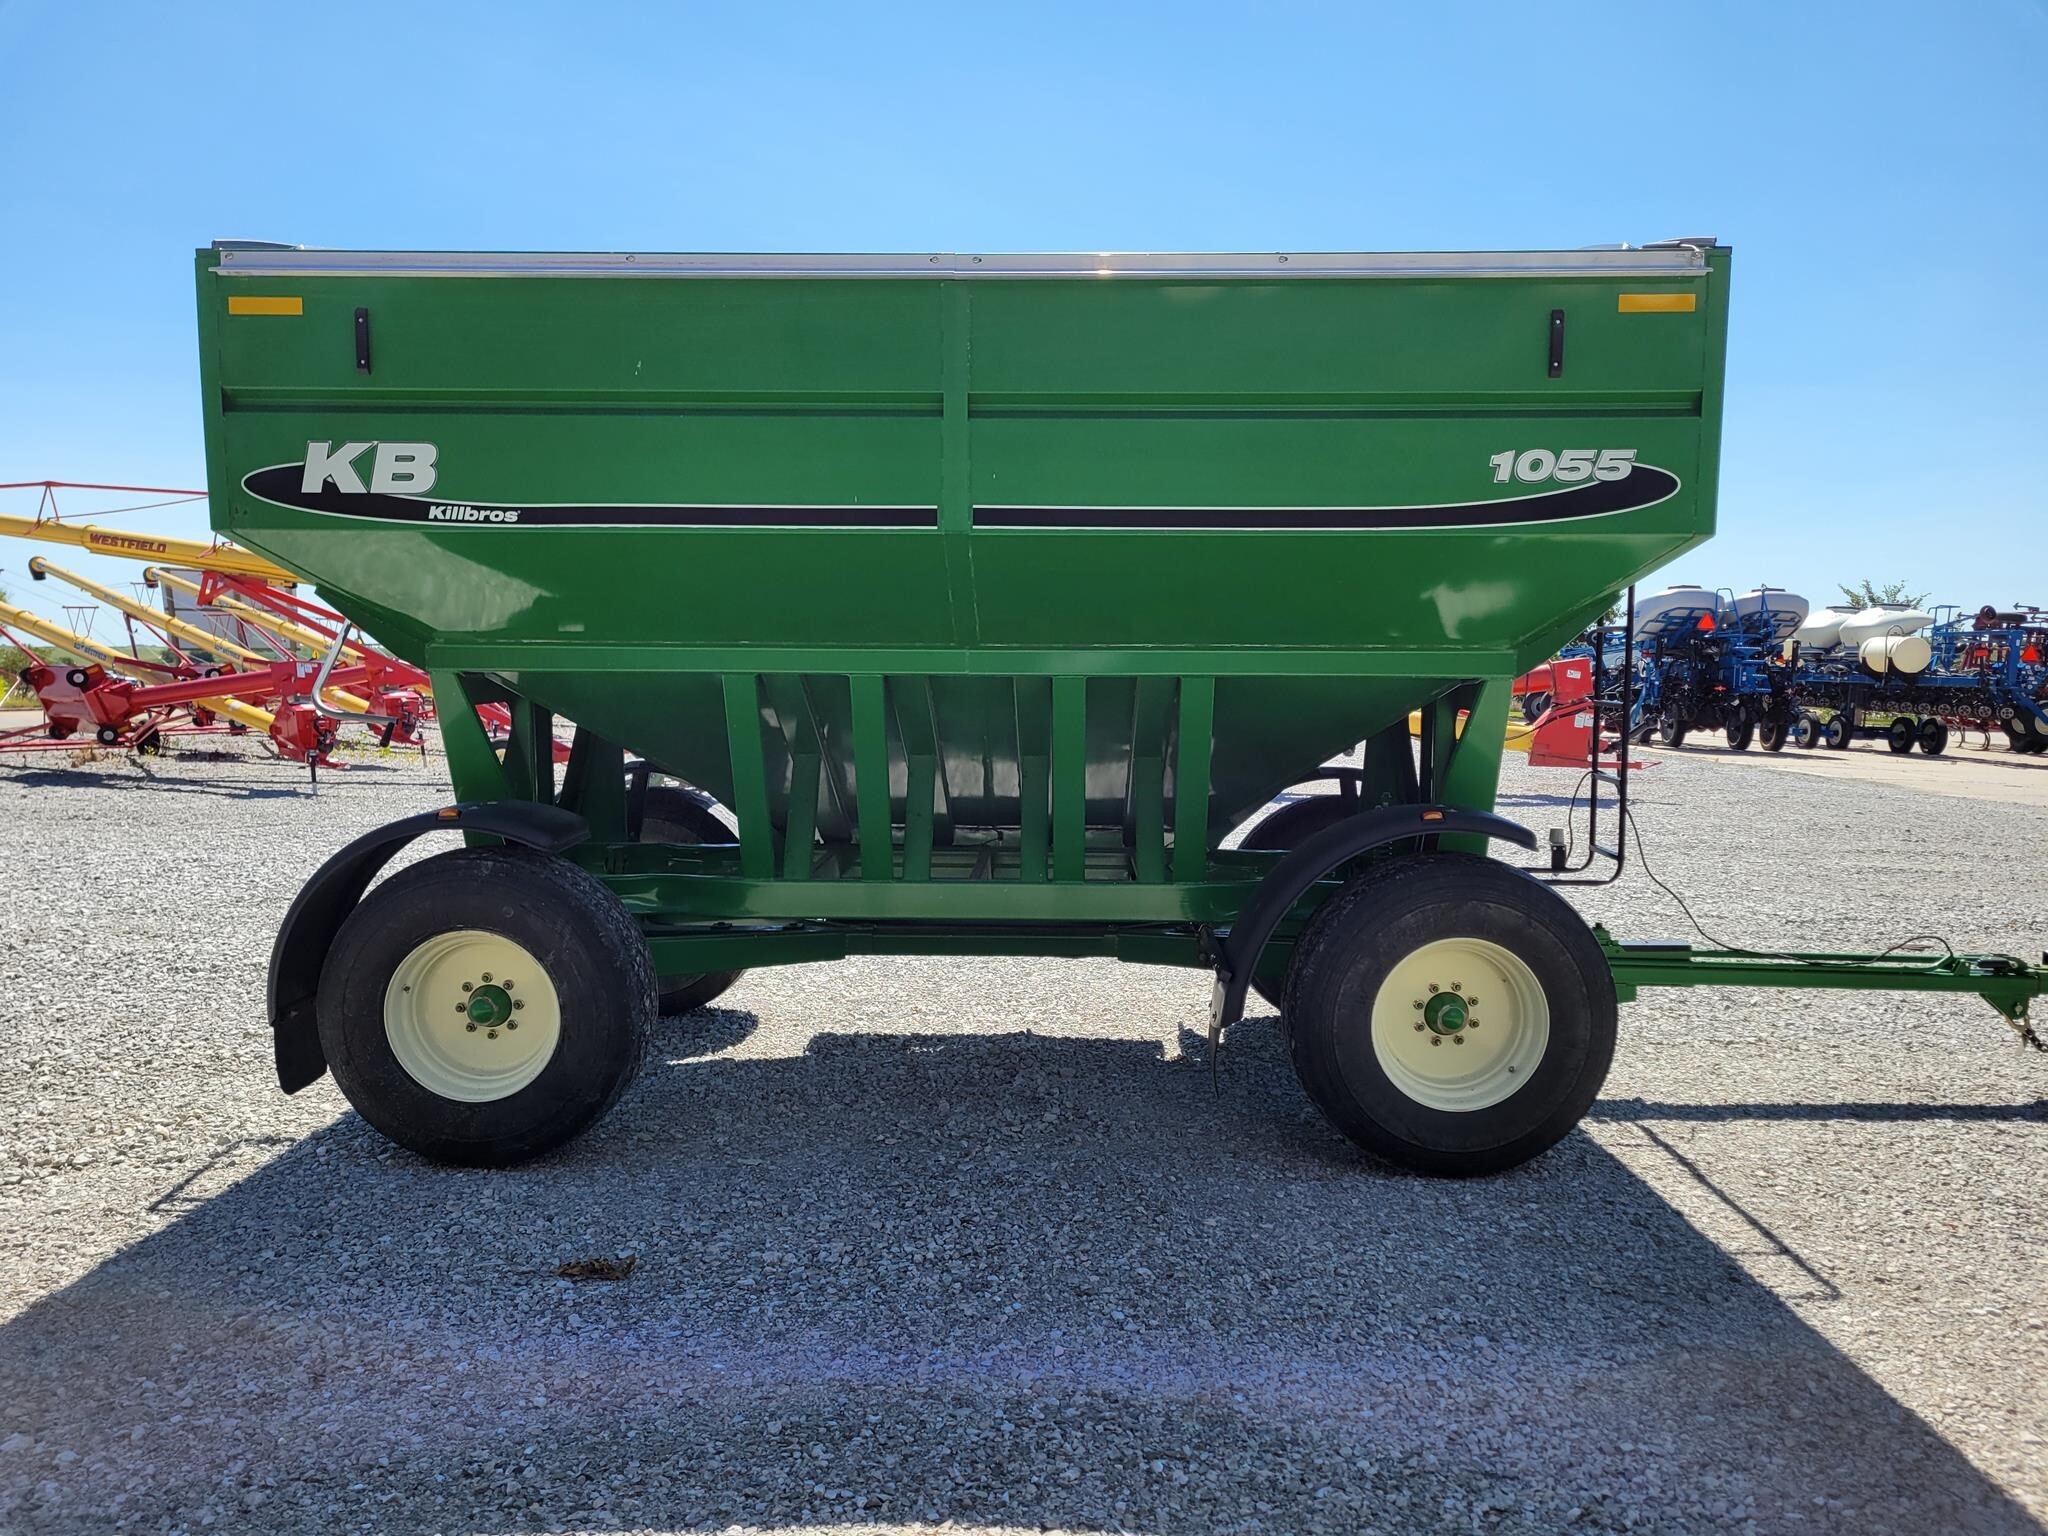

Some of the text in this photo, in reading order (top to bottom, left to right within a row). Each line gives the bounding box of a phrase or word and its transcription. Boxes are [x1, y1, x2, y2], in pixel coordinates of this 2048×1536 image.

[301, 440, 438, 494] KB
[1489, 448, 1637, 484] 1055
[428, 505, 520, 523] Killbros
[90, 533, 167, 553] WESTFIELD
